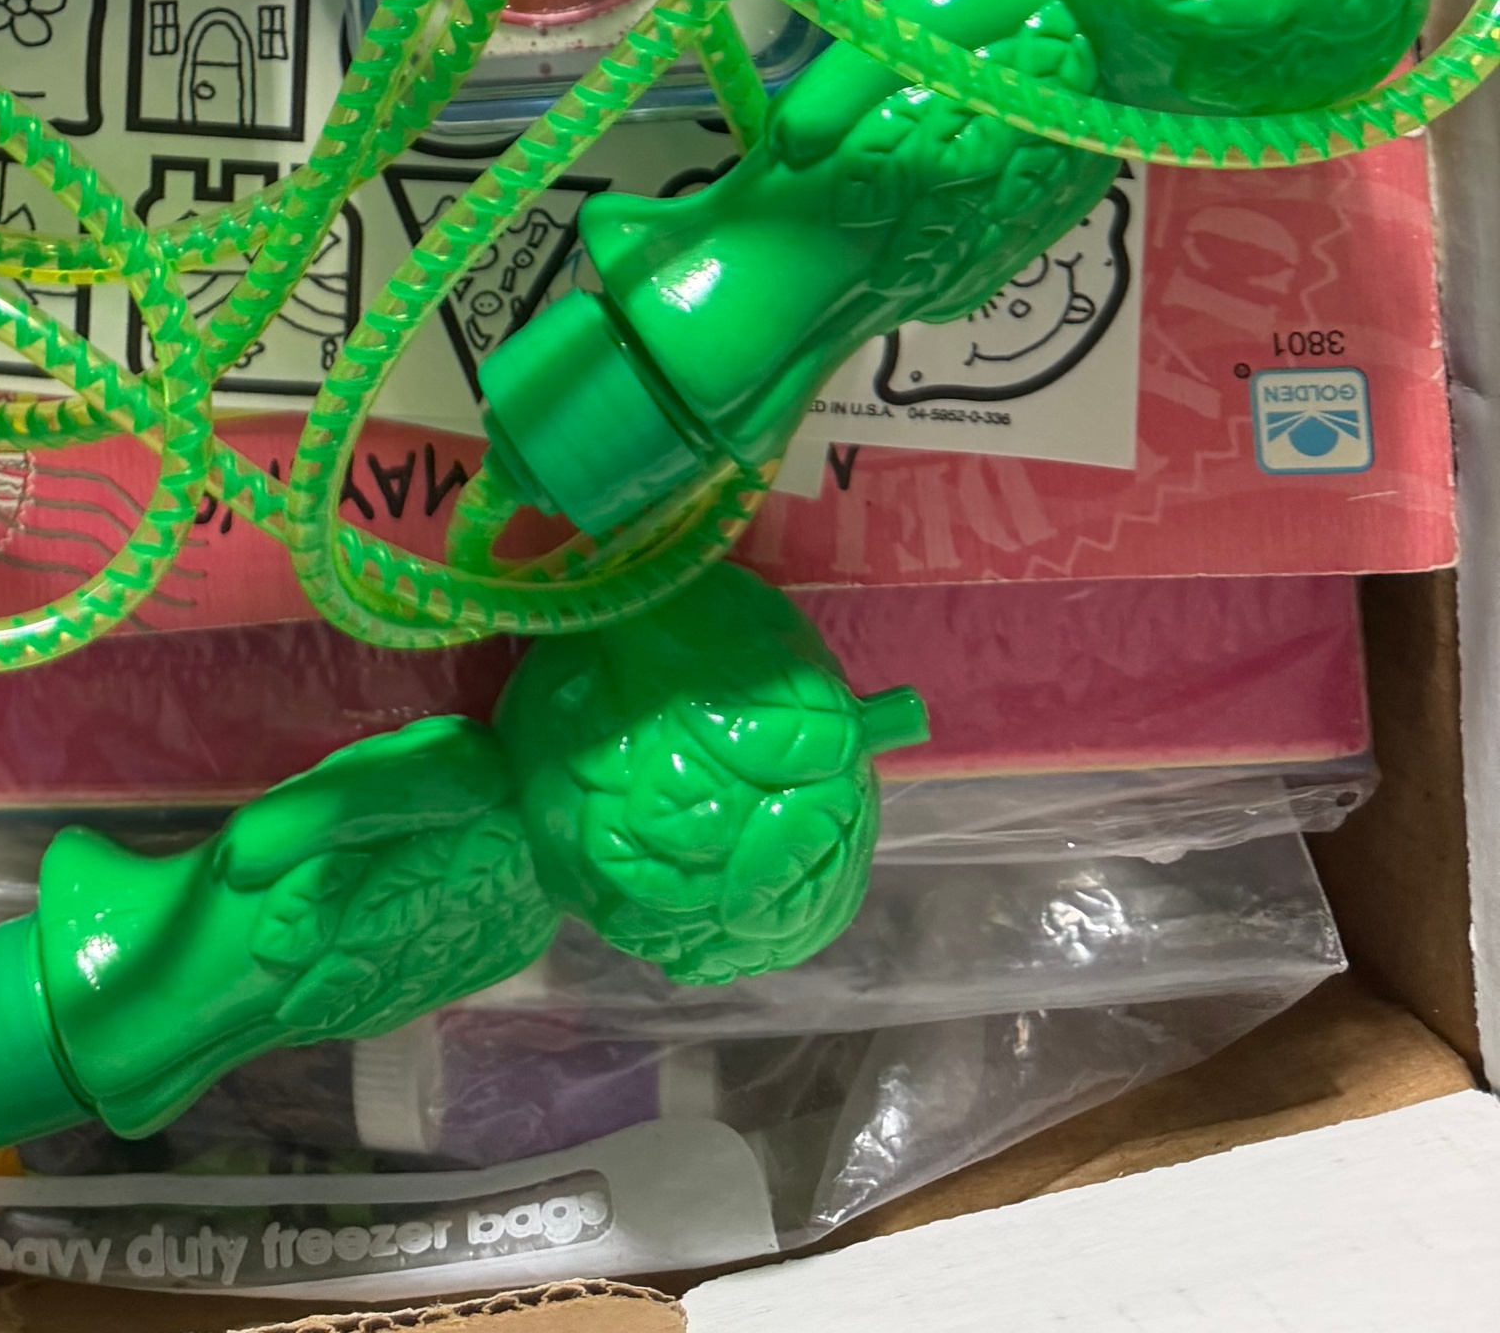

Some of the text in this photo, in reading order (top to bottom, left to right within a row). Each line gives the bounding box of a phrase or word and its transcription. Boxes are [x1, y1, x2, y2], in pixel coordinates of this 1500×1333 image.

[1273, 329, 1346, 357] 3801
[1262, 384, 1358, 405] GOLDEN
[126, 1224, 246, 1285] duty
[262, 1220, 452, 1269] freezer
[466, 1191, 610, 1245] bags
